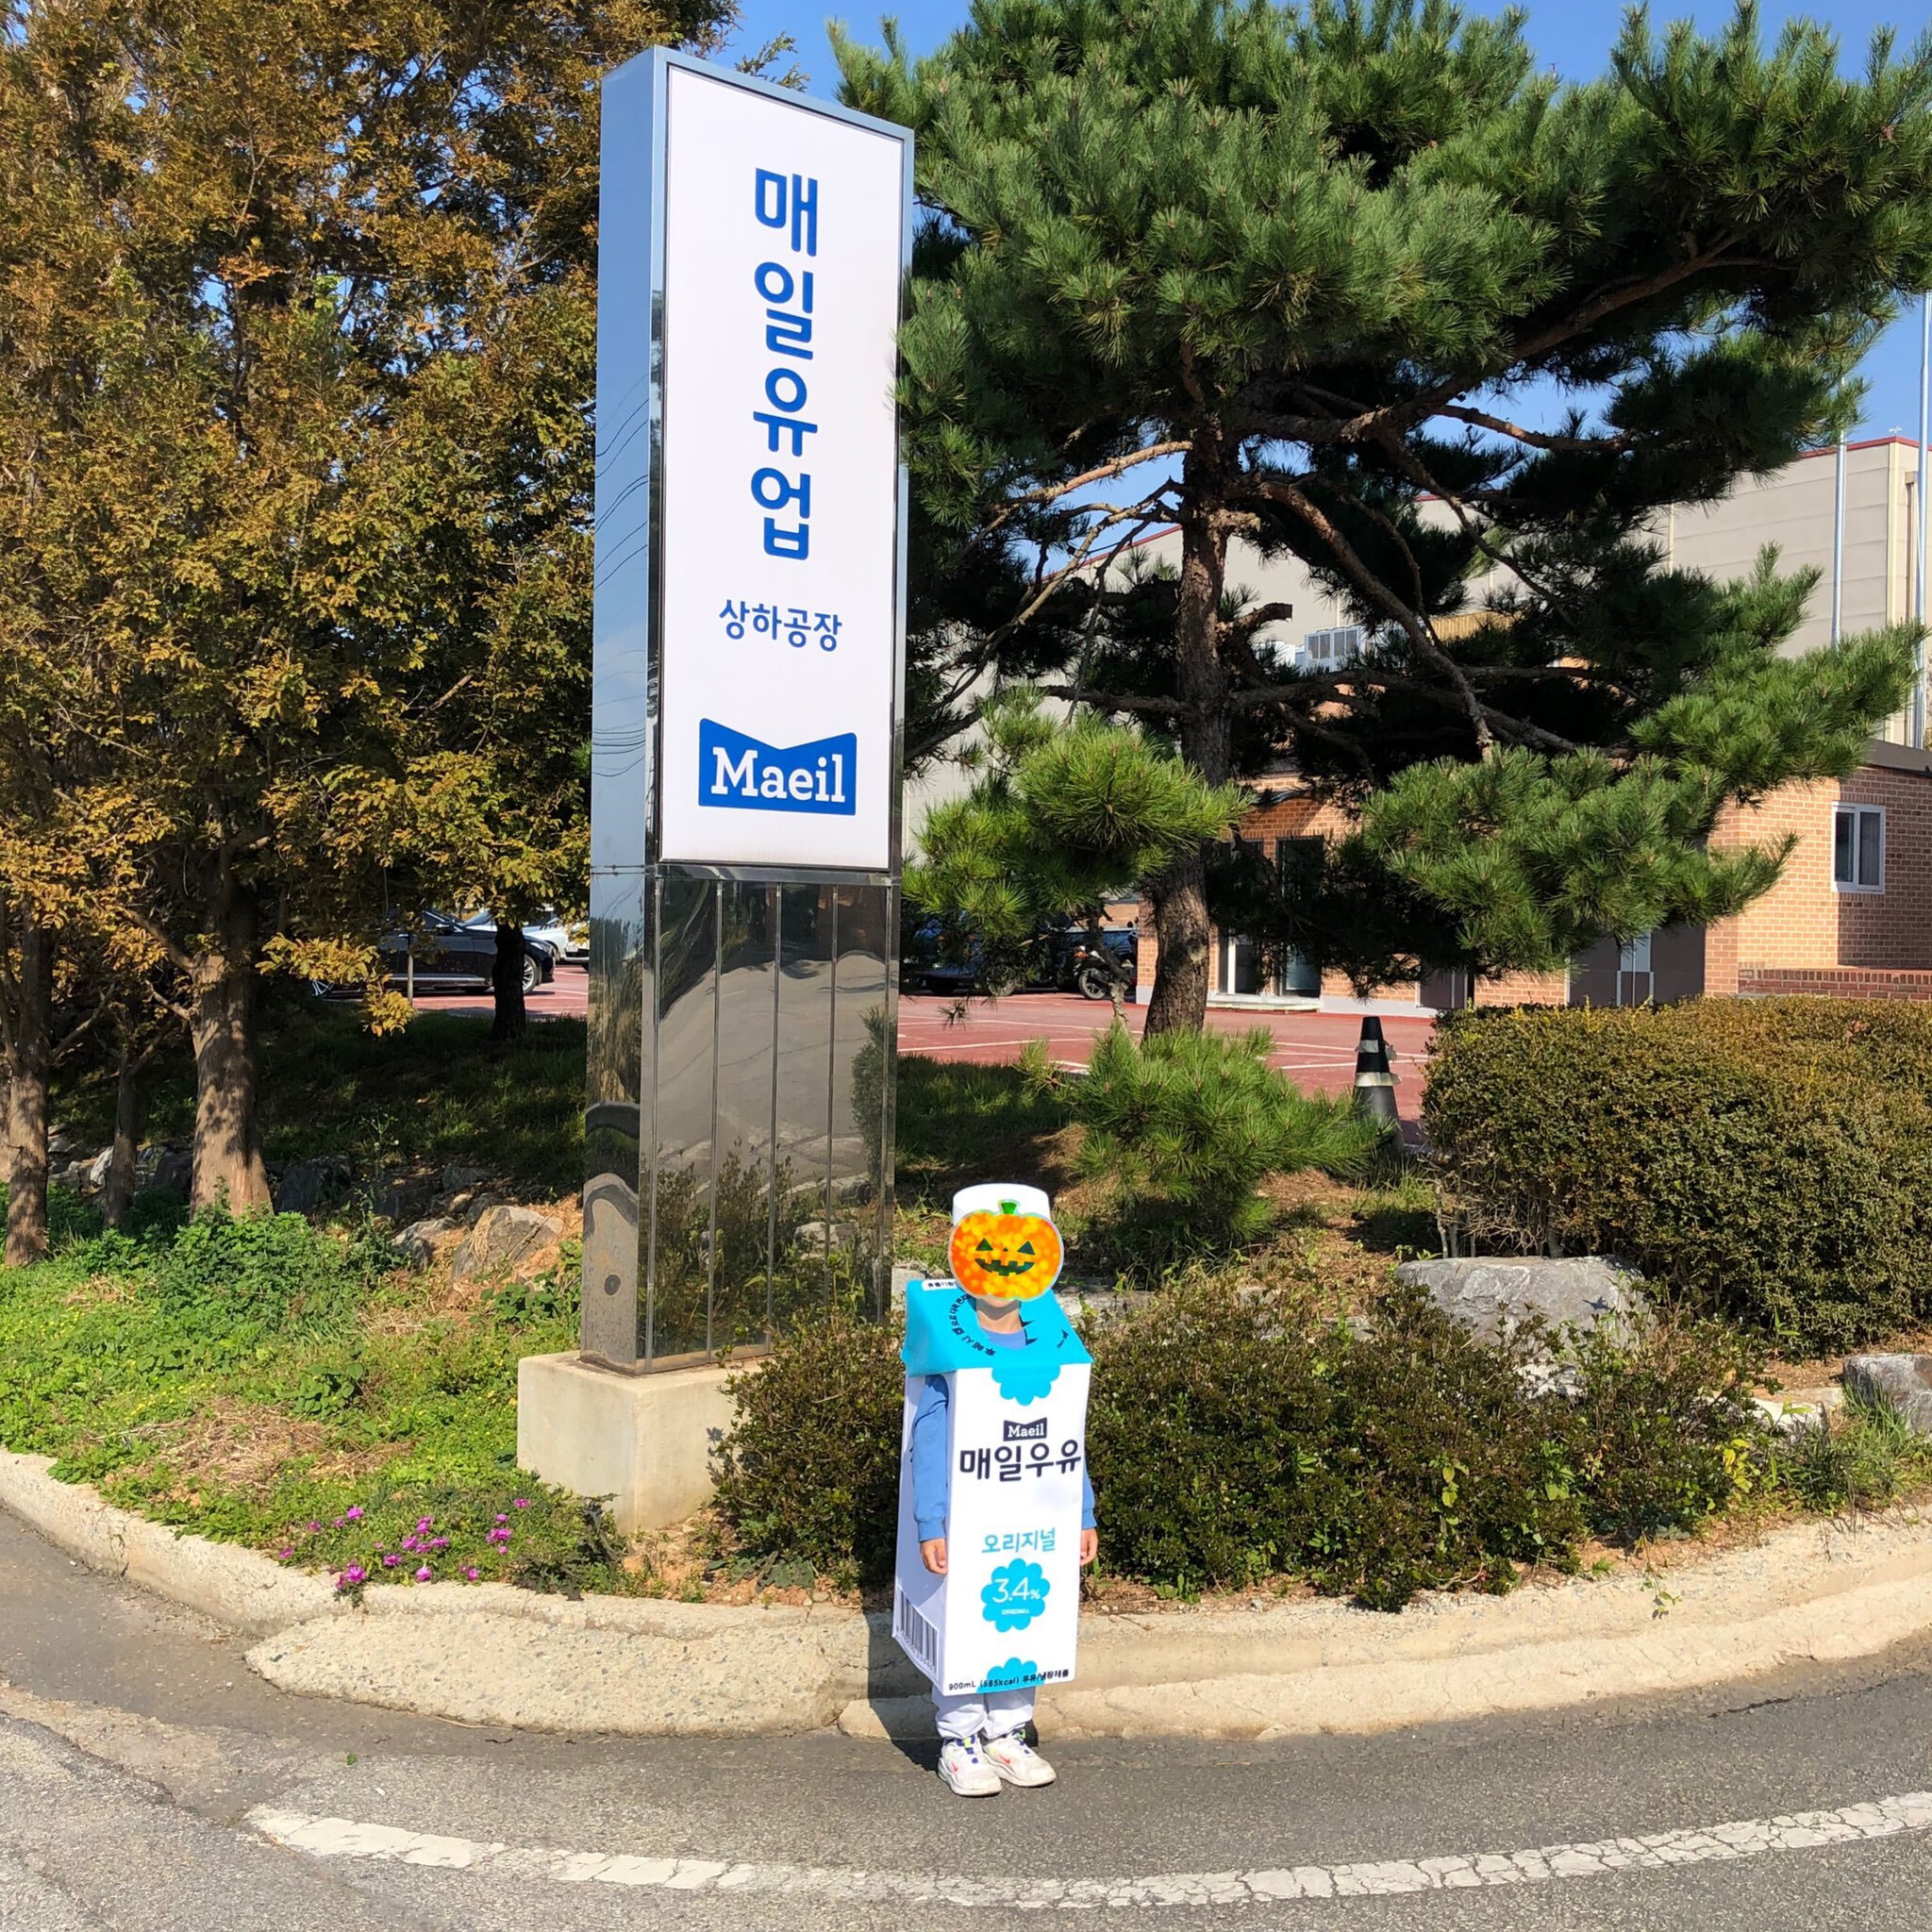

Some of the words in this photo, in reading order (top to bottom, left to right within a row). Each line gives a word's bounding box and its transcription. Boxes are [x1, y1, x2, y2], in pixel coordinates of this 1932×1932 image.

[750, 167, 818, 561] 매일유업
[719, 599, 842, 652] 상하공장
[710, 746, 845, 803] Maeil
[1008, 1423, 1044, 1439] Maeil
[959, 1440, 1081, 1482] 매일우유
[981, 1527, 1056, 1554] 오리지널
[991, 1576, 1041, 1603] 3.4%
[948, 1680, 976, 1690] 900mL
